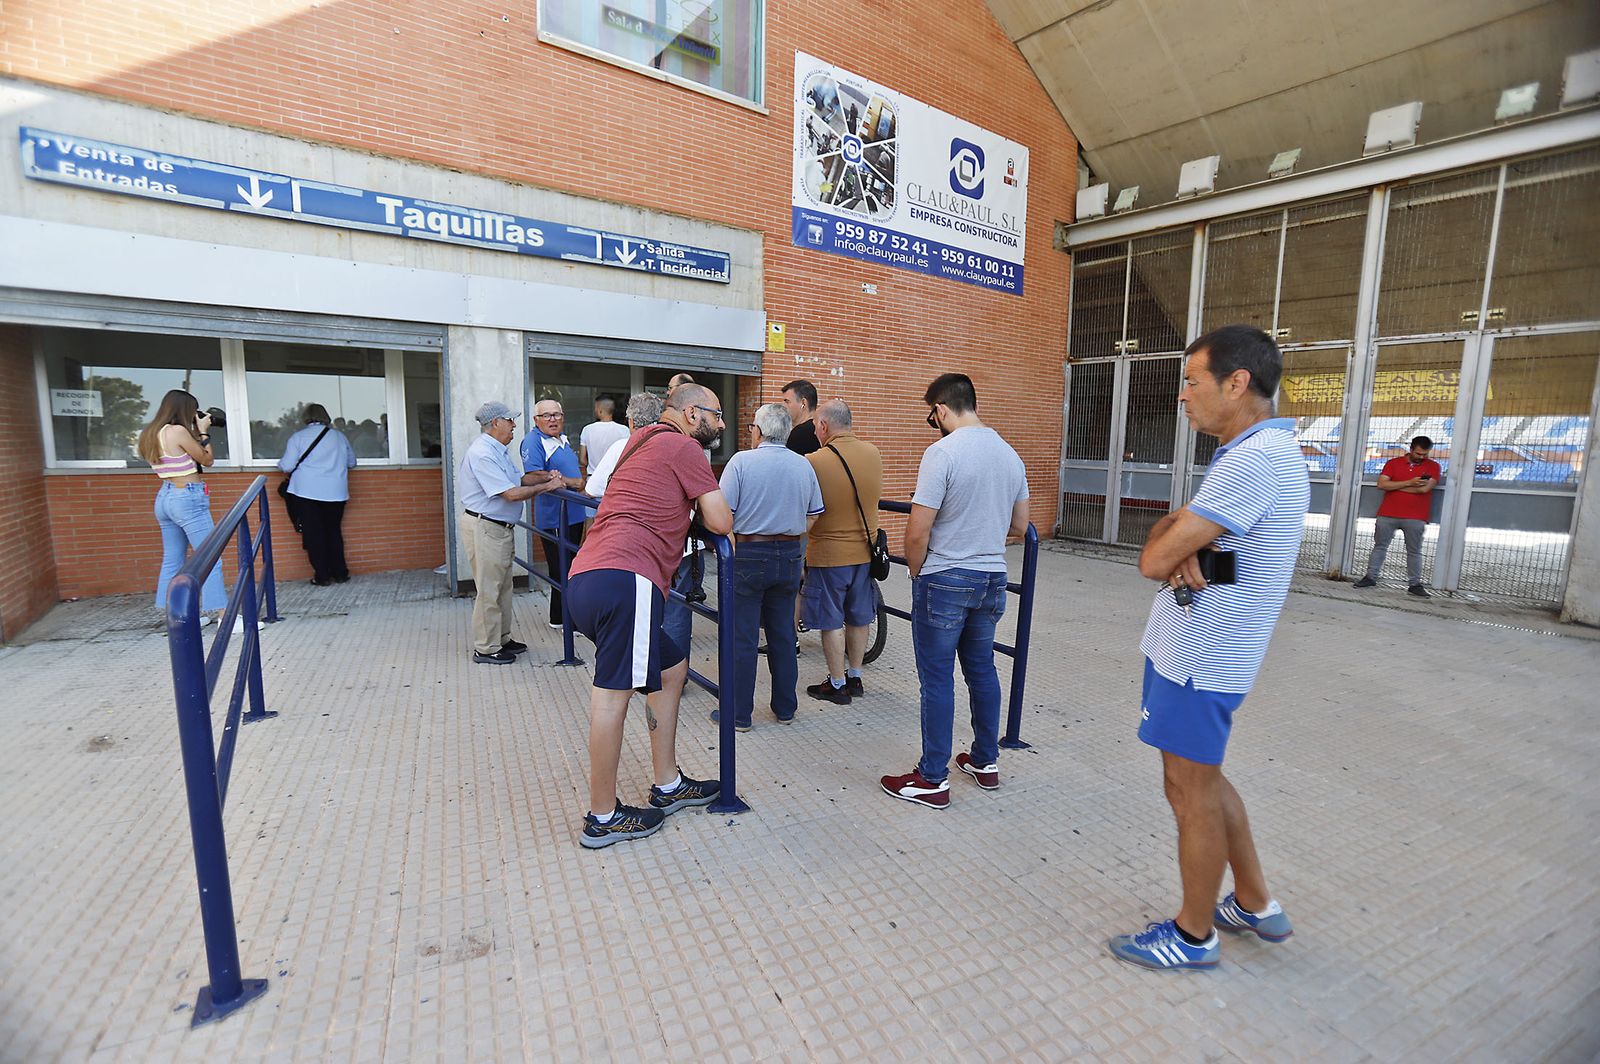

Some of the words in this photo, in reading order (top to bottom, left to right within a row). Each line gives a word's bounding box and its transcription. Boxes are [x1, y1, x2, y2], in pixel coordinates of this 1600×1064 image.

[55, 137, 135, 167] Venta
[143, 156, 175, 175] de
[58, 161, 179, 196] Entradas
[376, 196, 544, 247] Taquillas
[910, 207, 953, 229] EMPRESA
[954, 221, 1018, 248] CONSTRUCTORA
[646, 242, 685, 259] Salida
[834, 237, 929, 268] info@clauypaul.es
[835, 221, 865, 240] 959
[868, 229, 887, 245] 87
[891, 235, 909, 251] 52
[912, 241, 929, 256] 41
[941, 248, 964, 264] 959
[967, 255, 982, 270] 61
[985, 260, 999, 274] 00
[1002, 264, 1015, 278] 11
[645, 259, 656, 271] T.
[660, 260, 728, 280] Incidencias
[942, 265, 1015, 289] www.clauypaul.es
[56, 391, 96, 399] RECOGIDA
